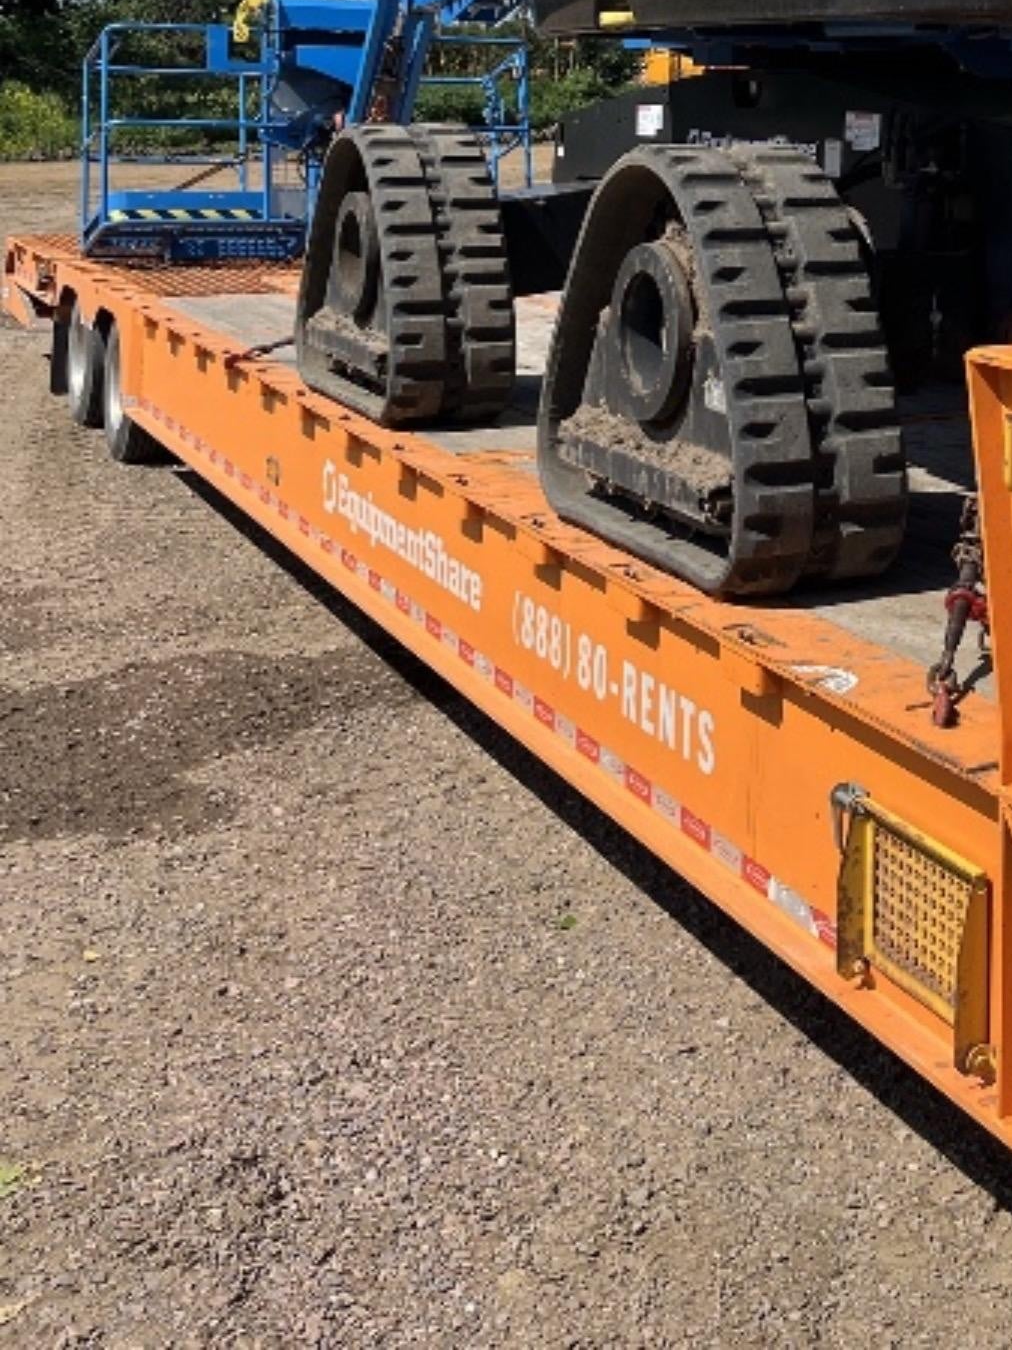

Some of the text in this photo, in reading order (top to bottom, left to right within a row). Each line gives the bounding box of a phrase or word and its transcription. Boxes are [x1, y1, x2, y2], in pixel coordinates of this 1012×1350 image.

[337, 473, 482, 614] EquipmentShare
[512, 589, 716, 775] (888) 80-RENTS
